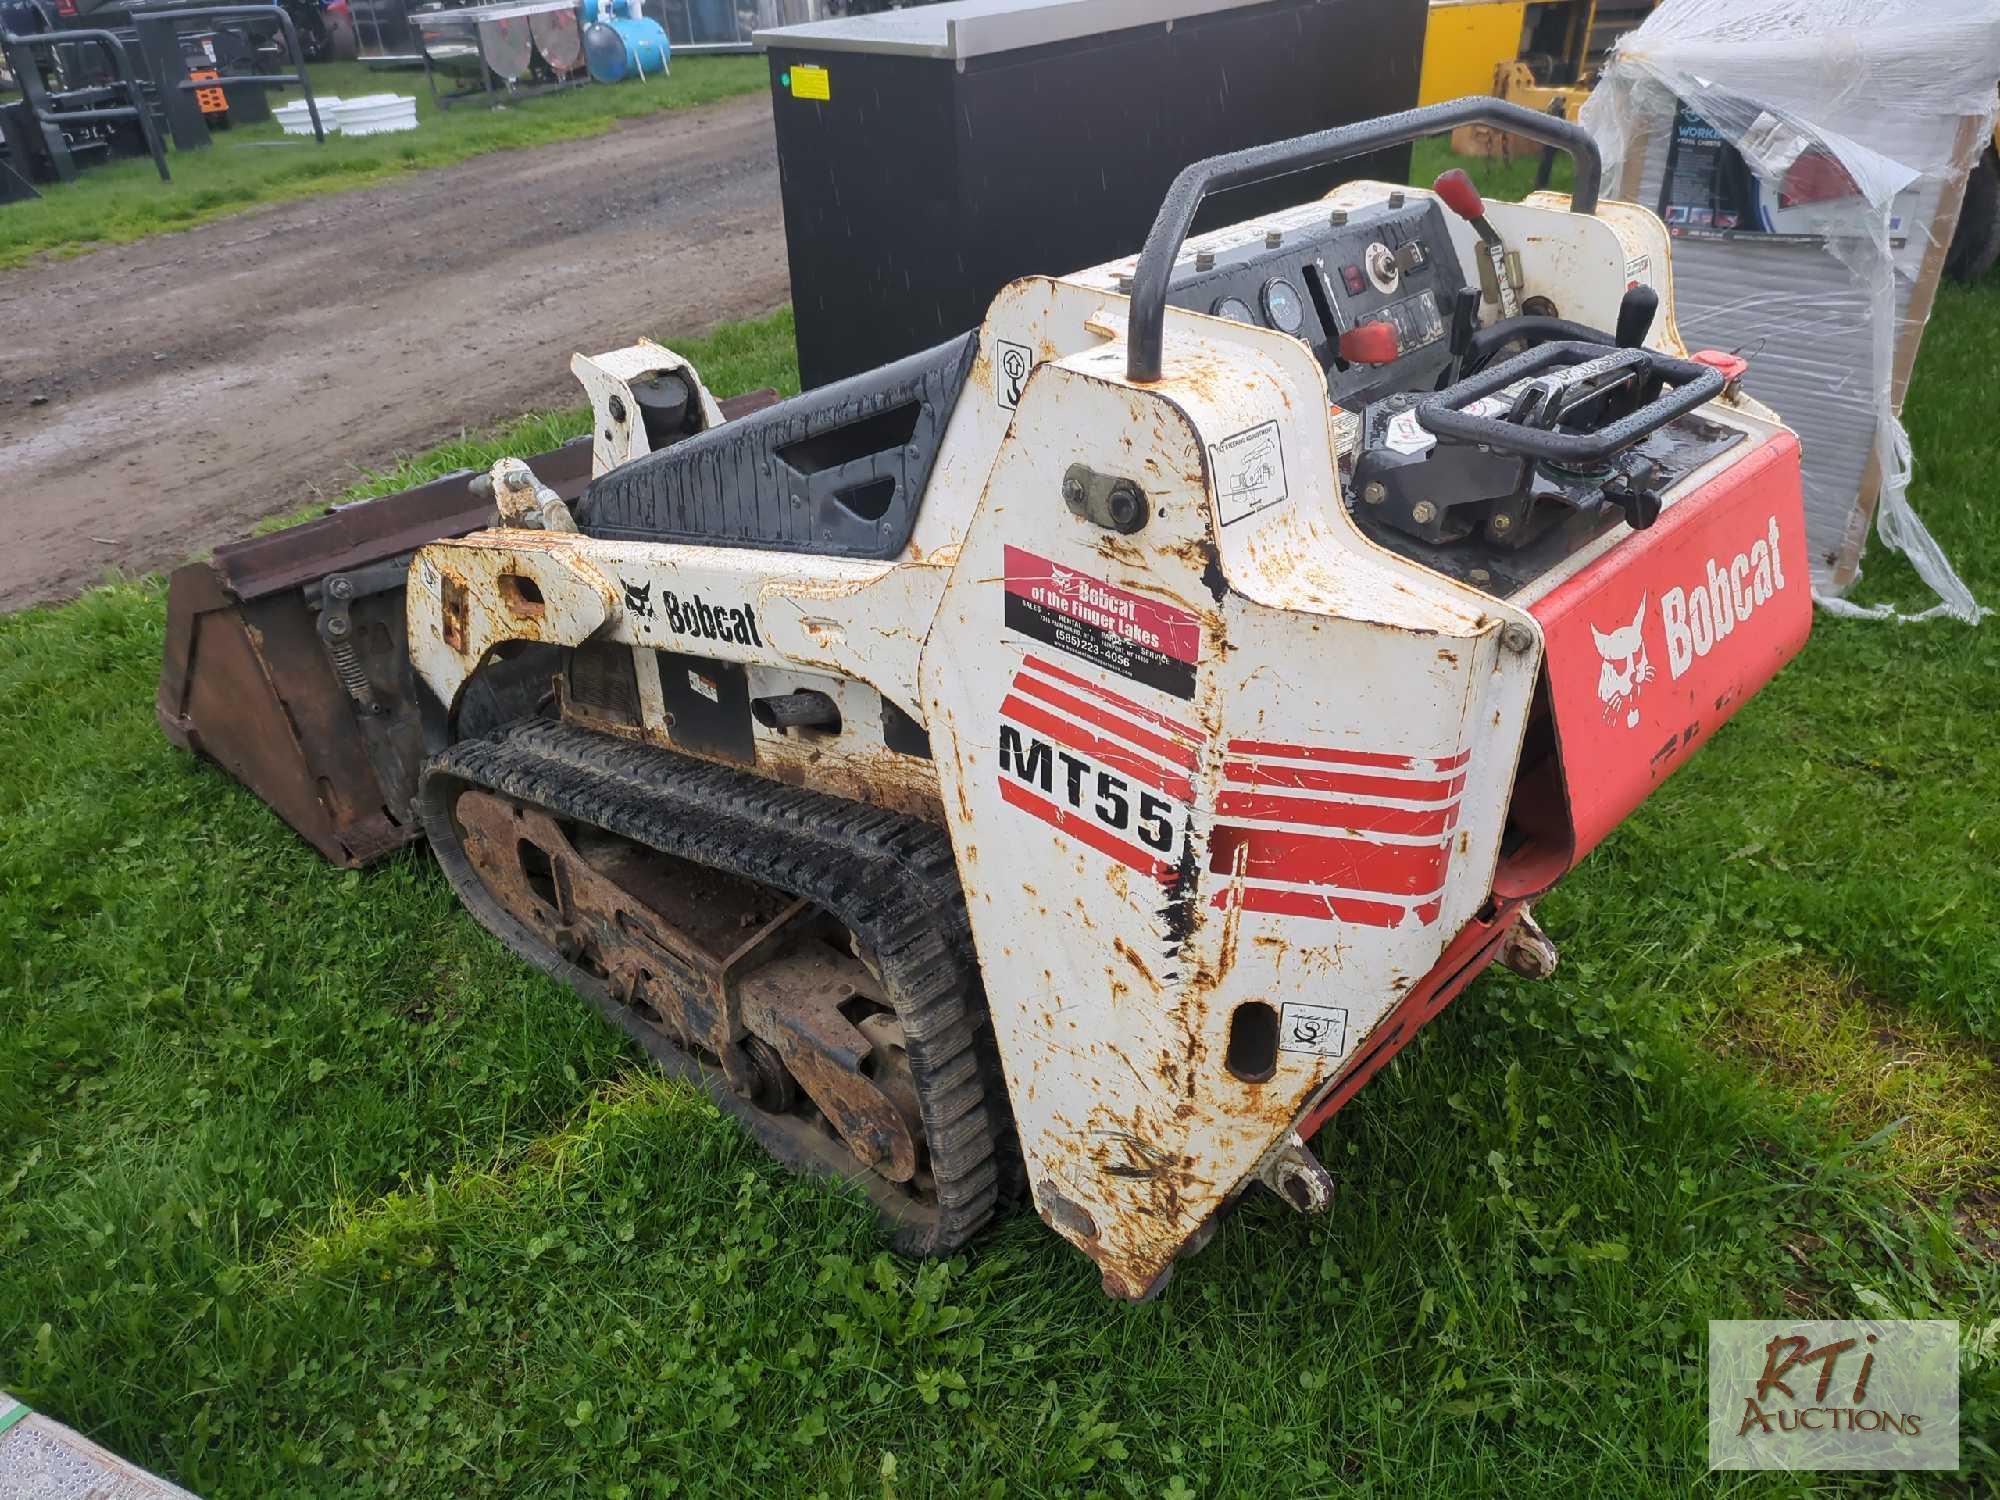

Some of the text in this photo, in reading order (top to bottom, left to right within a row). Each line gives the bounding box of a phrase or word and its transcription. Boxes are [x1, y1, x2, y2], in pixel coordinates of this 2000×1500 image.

[663, 590, 763, 648] Bobcat
[1031, 587, 1045, 603] of
[1047, 591, 1069, 611] the
[1072, 600, 1115, 631] Finger
[1118, 618, 1160, 648] Lakes
[1079, 580, 1135, 621] Bobcat
[1661, 515, 1785, 681] Bobcat
[999, 724, 1173, 852] MT55
